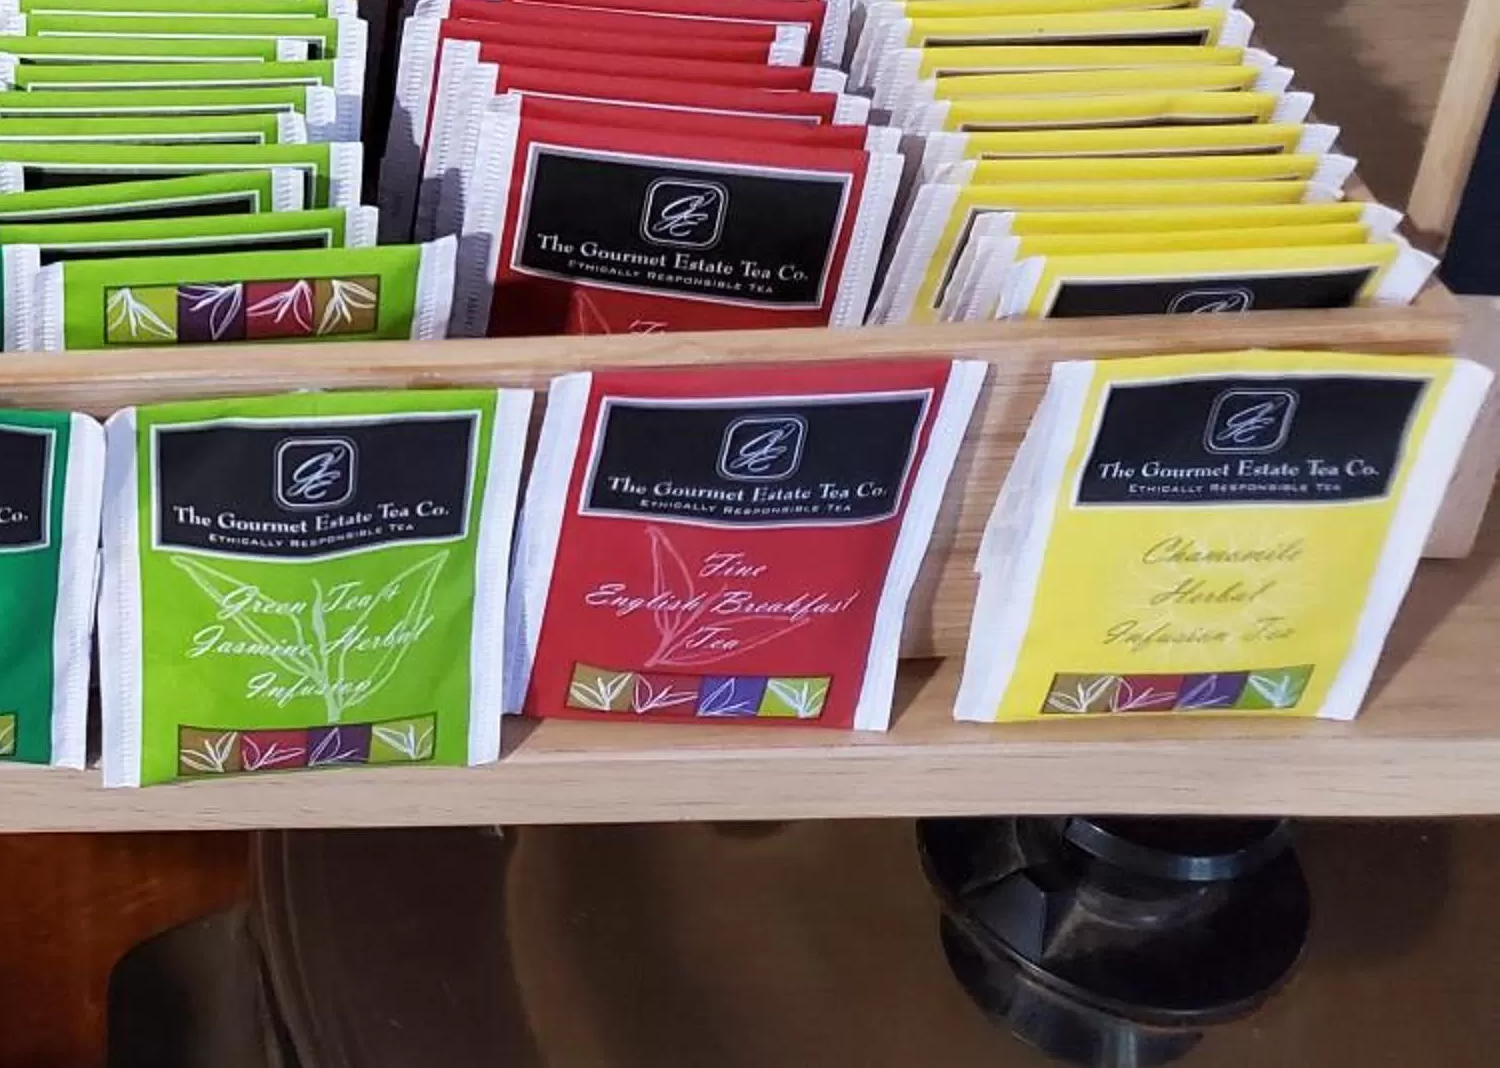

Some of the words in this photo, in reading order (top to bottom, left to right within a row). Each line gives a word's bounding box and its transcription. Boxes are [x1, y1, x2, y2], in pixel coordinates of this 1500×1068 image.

[537, 232, 574, 253] The
[580, 240, 666, 268] Gourmet
[673, 252, 734, 276] Estate
[740, 260, 771, 280] Tea
[778, 263, 809, 282] Co.
[1099, 460, 1136, 479] The
[1141, 460, 1229, 479] Gourmet
[1237, 459, 1300, 478] Estate
[1306, 458, 1340, 477] Tea
[1345, 458, 1381, 477] Co.
[607, 475, 647, 496] The
[653, 481, 745, 502] Gourmet
[752, 486, 813, 502] Estate
[819, 482, 850, 500] Tea
[856, 481, 888, 498] Co.
[173, 505, 212, 527] The
[217, 512, 308, 533] Gourmet
[315, 512, 373, 532] Estate
[378, 502, 409, 520] Tea
[415, 500, 450, 518] Co.
[584, 582, 708, 617] English
[709, 588, 862, 624] Breakfast
[685, 626, 740, 650] Tea
